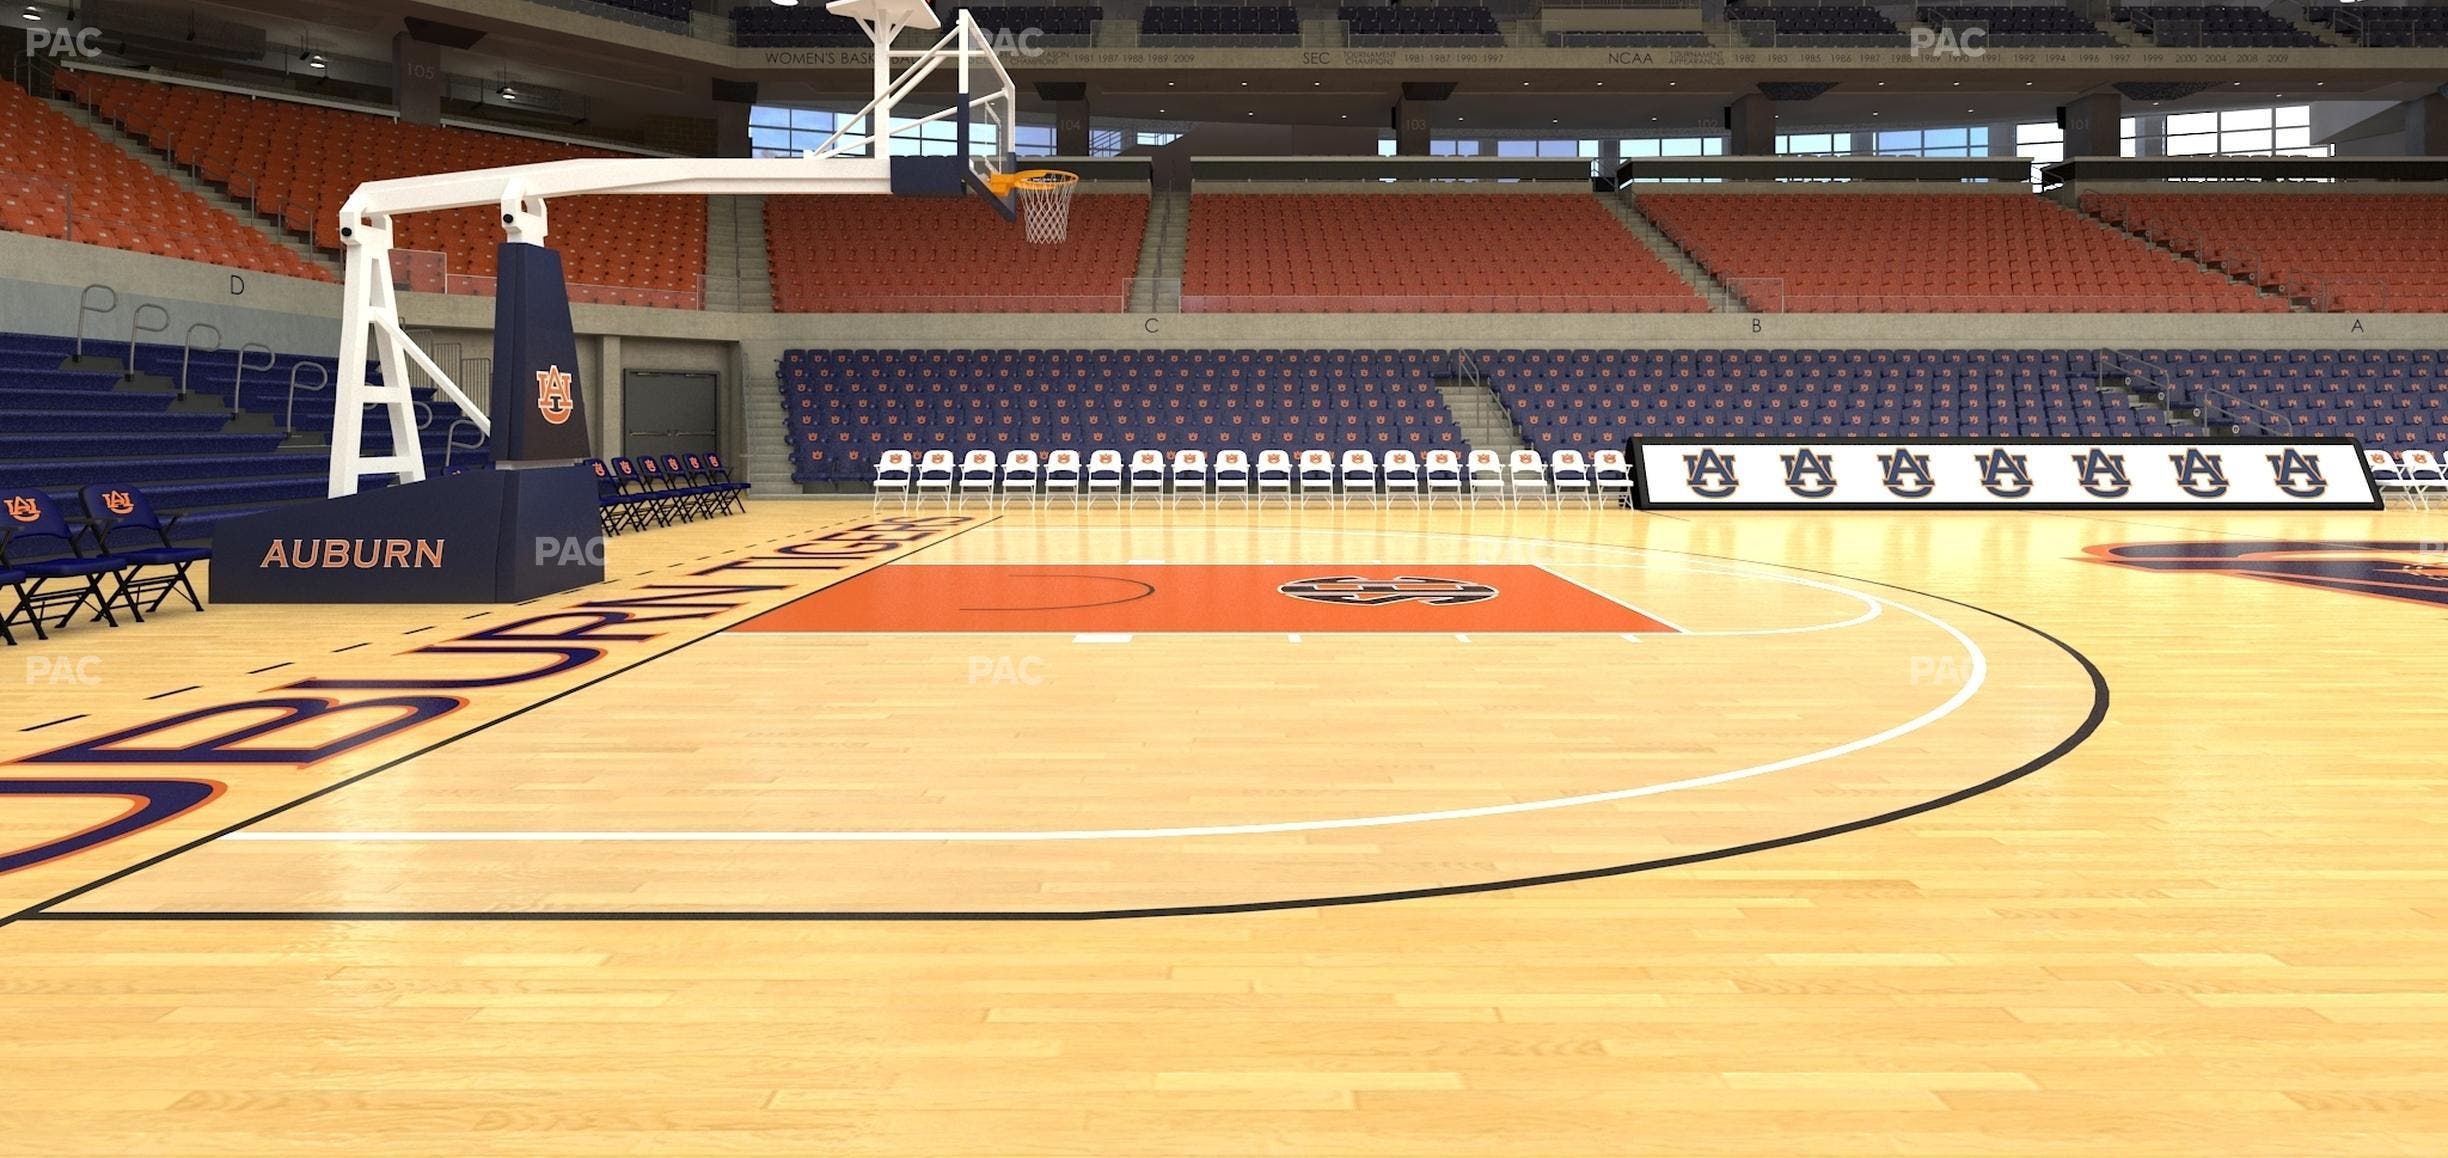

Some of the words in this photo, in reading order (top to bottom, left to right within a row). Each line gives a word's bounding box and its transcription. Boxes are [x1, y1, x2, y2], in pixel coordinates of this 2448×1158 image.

[765, 52, 835, 65] WOMEN'S
[1302, 51, 1330, 65] SEC
[1608, 51, 1653, 65] NCAA
[408, 62, 434, 80] 105
[230, 274, 245, 296] D
[1144, 317, 1159, 334] C
[1752, 317, 1762, 333] B
[2351, 318, 2365, 333] A
[259, 538, 445, 569] AUBURN
[686, 515, 977, 577] TIGERS
